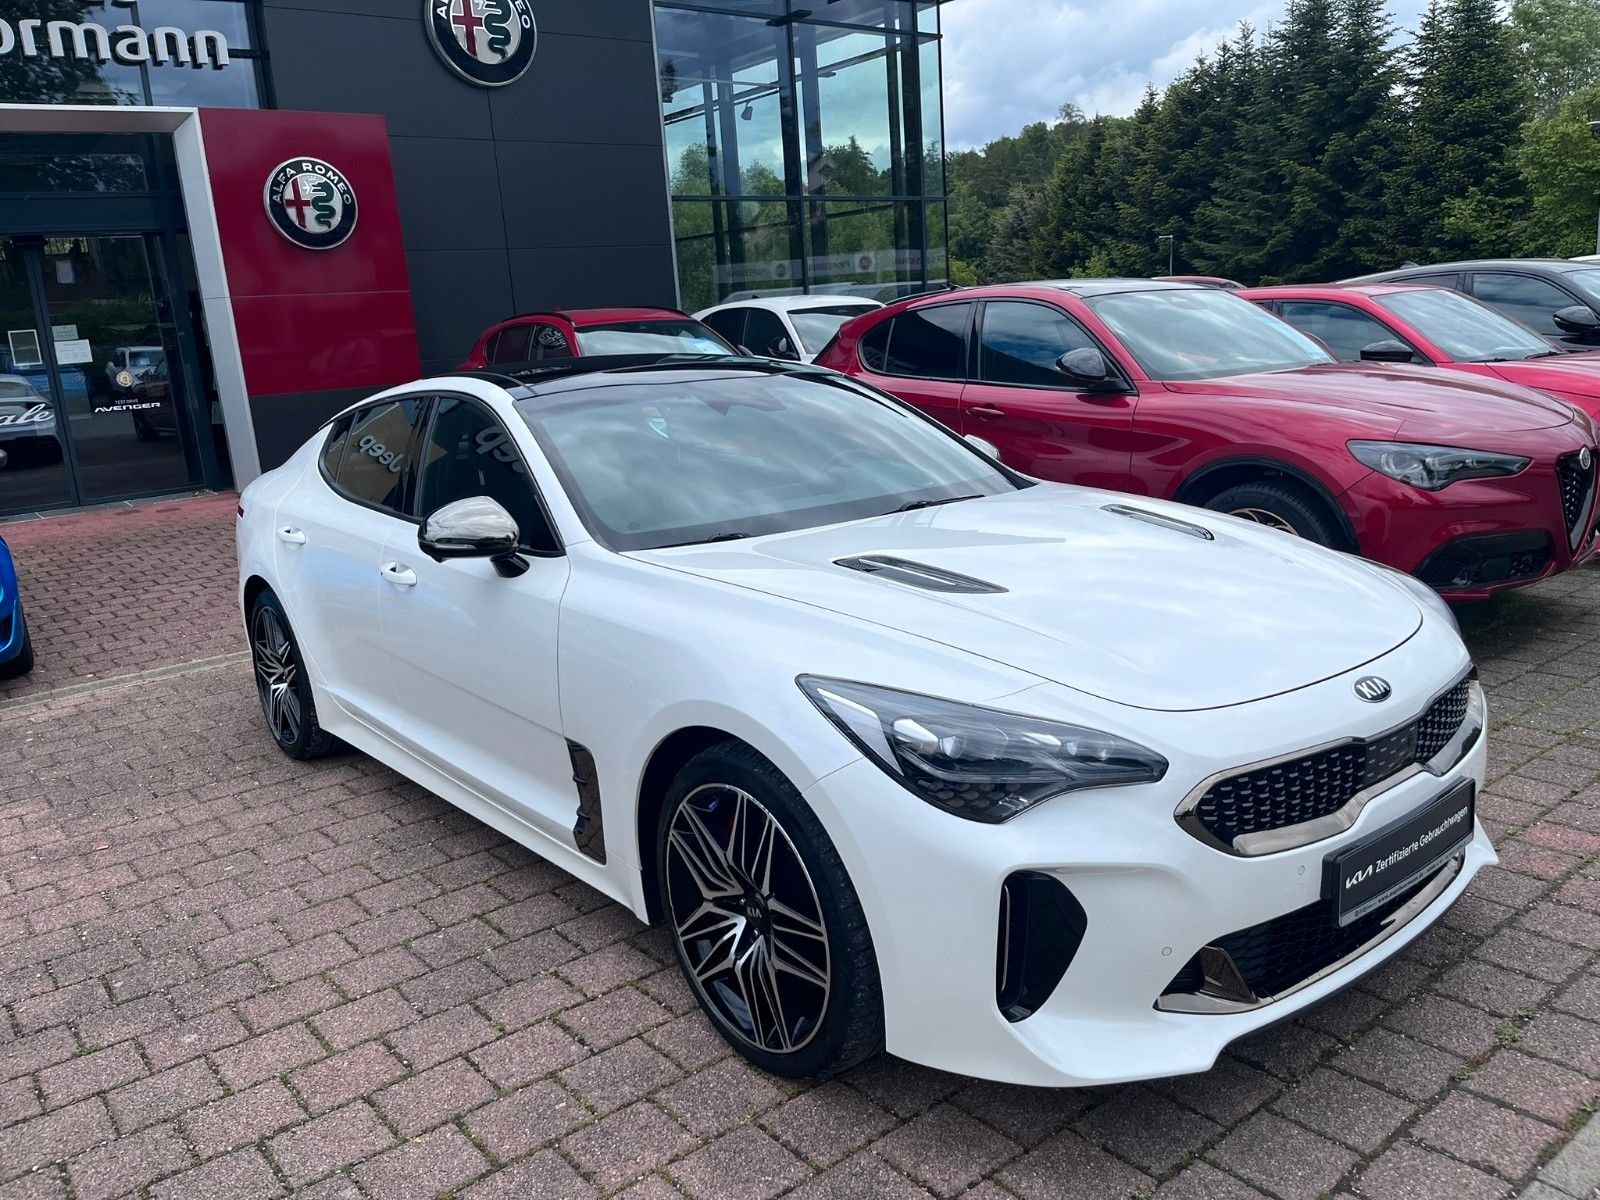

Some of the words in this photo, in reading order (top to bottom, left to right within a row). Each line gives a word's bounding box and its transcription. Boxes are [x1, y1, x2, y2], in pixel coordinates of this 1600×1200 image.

[272, 167, 297, 204] ALFA
[301, 162, 352, 205] ROMEO
[94, 402, 161, 413] AVENGER
[1355, 677, 1390, 699] KIA
[1376, 840, 1419, 873] Zertifizierte
[1419, 806, 1468, 847] Gebrauchtwagen
